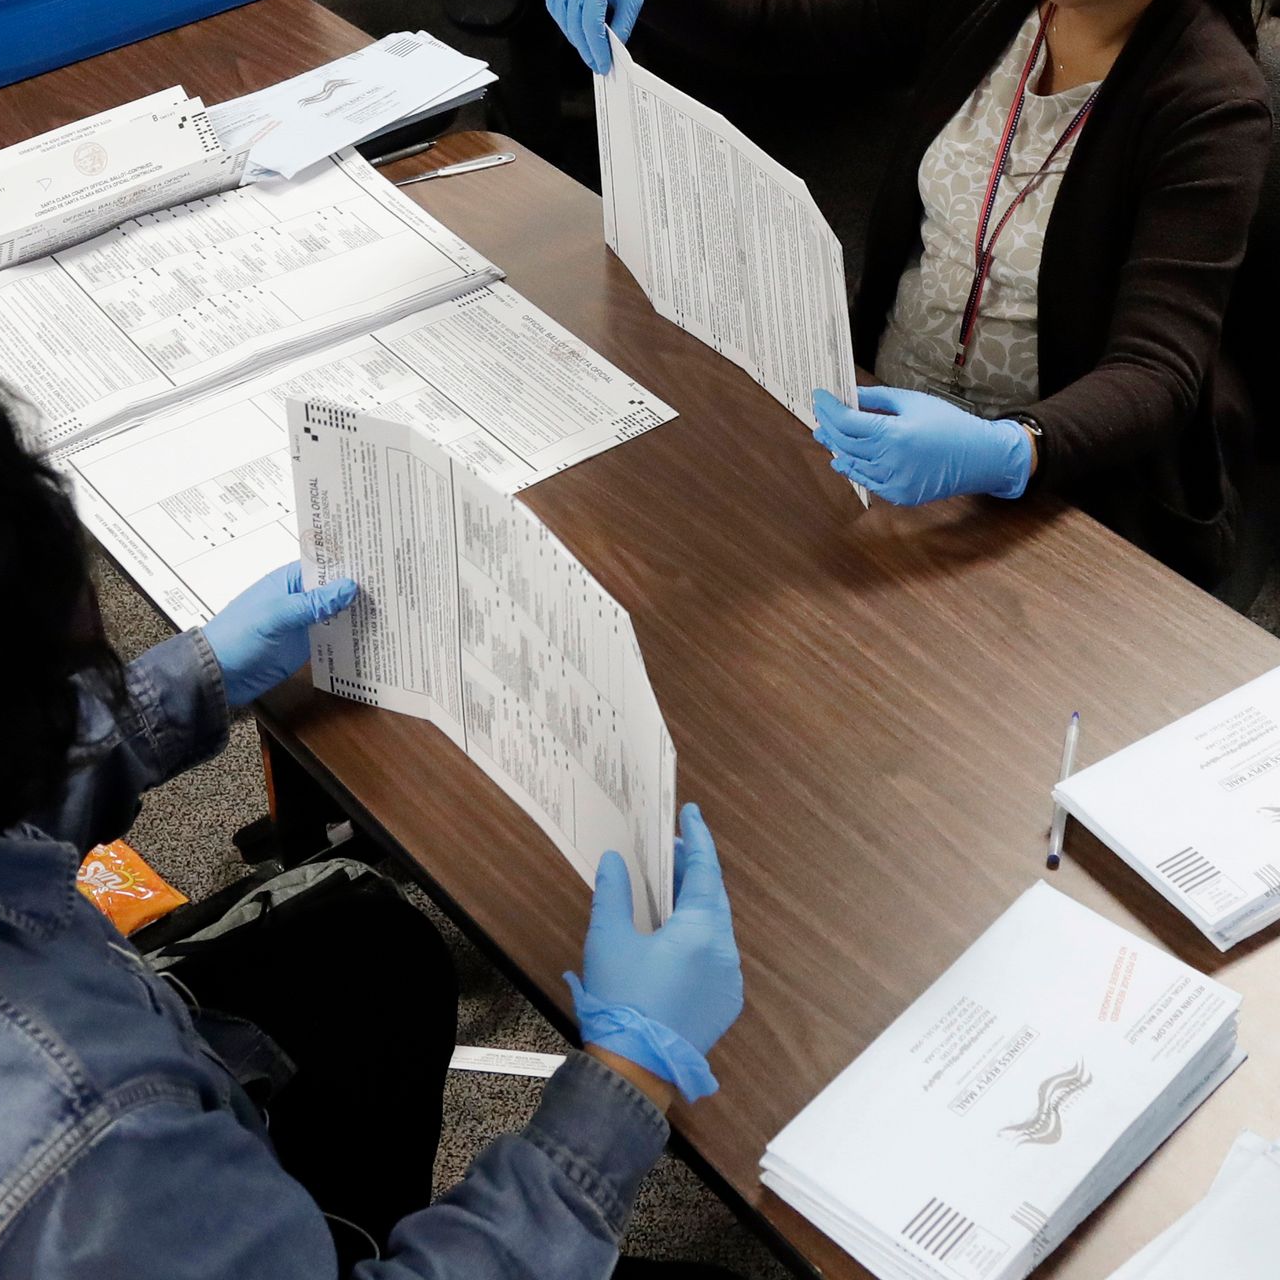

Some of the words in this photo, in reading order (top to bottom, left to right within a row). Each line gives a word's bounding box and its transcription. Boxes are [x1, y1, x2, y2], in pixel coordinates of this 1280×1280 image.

[152, 114, 158, 122] B
[40, 198, 55, 208] SANTA
[55, 193, 71, 202] CLARA
[70, 186, 90, 197] COUNTY
[89, 178, 110, 190] OFFICIAL
[63, 196, 79, 206] SANTA
[78, 190, 95, 200] CLARA
[94, 183, 113, 194] BOLETA
[61, 207, 96, 223] OFFICIAL
[521, 312, 546, 335] OFFICIAL
[544, 329, 568, 352] BALLOT
[568, 347, 592, 369] BOLETA
[589, 363, 614, 385] OFICIAL
[308, 477, 319, 510] OFICIAL
[321, 489, 330, 518] GENERAL
[311, 512, 323, 546] BOLETA
[315, 552, 327, 585] BALLOT
[367, 575, 376, 606] VOTANTES
[349, 604, 358, 627] VOTERS
[370, 620, 378, 637] PARA
[351, 635, 361, 678] INSTRUCTIONS
[371, 638, 381, 683] INSTRUCCIONES
[1225, 773, 1247, 790] MAIL
[1246, 759, 1271, 778] REPLY
[1170, 974, 1191, 999] OFFICIAL
[1179, 982, 1205, 1012] RETURN
[1153, 1007, 1163, 1017] BY
[1159, 994, 1174, 1011] VOTE
[1143, 1012, 1157, 1028] MAIL
[1150, 1006, 1184, 1045] ENVELOPE
[1126, 1023, 1147, 1046] BALLOT
[995, 1029, 1035, 1068] BUSINESS
[974, 1064, 1001, 1092] REPLY
[954, 1088, 978, 1112] MAIL
